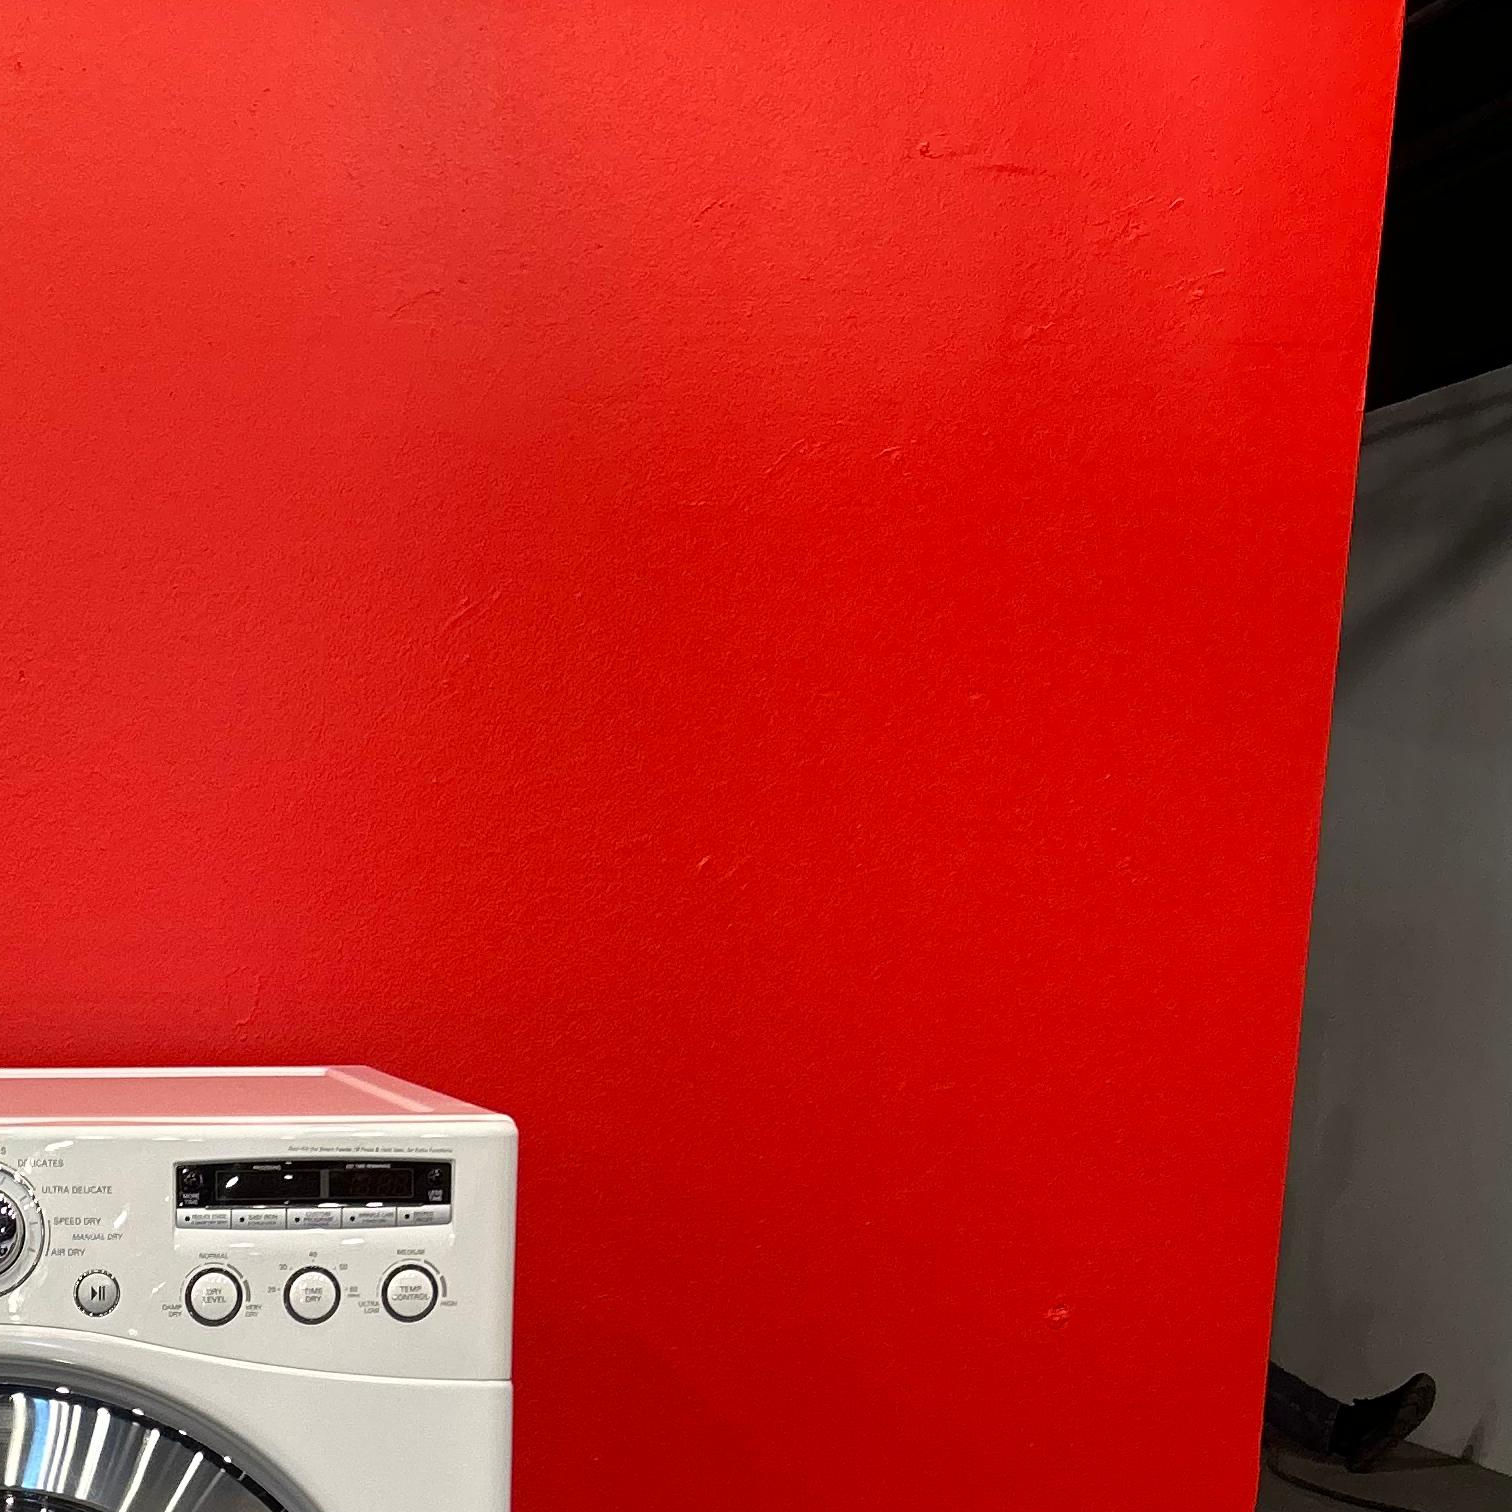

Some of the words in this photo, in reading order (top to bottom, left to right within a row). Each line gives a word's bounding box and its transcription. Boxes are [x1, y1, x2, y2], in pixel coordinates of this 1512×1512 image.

[41, 1185, 69, 1194] ULTRA
[72, 1186, 113, 1195] DELICATE
[53, 1217, 81, 1226] SPEED
[83, 1217, 102, 1226] DRY
[107, 1233, 124, 1241] DRY
[50, 1247, 65, 1257] AIR
[67, 1247, 86, 1257] DRY
[400, 1285, 423, 1293] TEMP
[202, 1295, 226, 1304] LEVEL
[305, 1295, 322, 1303] DRY
[392, 1293, 430, 1302] CONTROL
